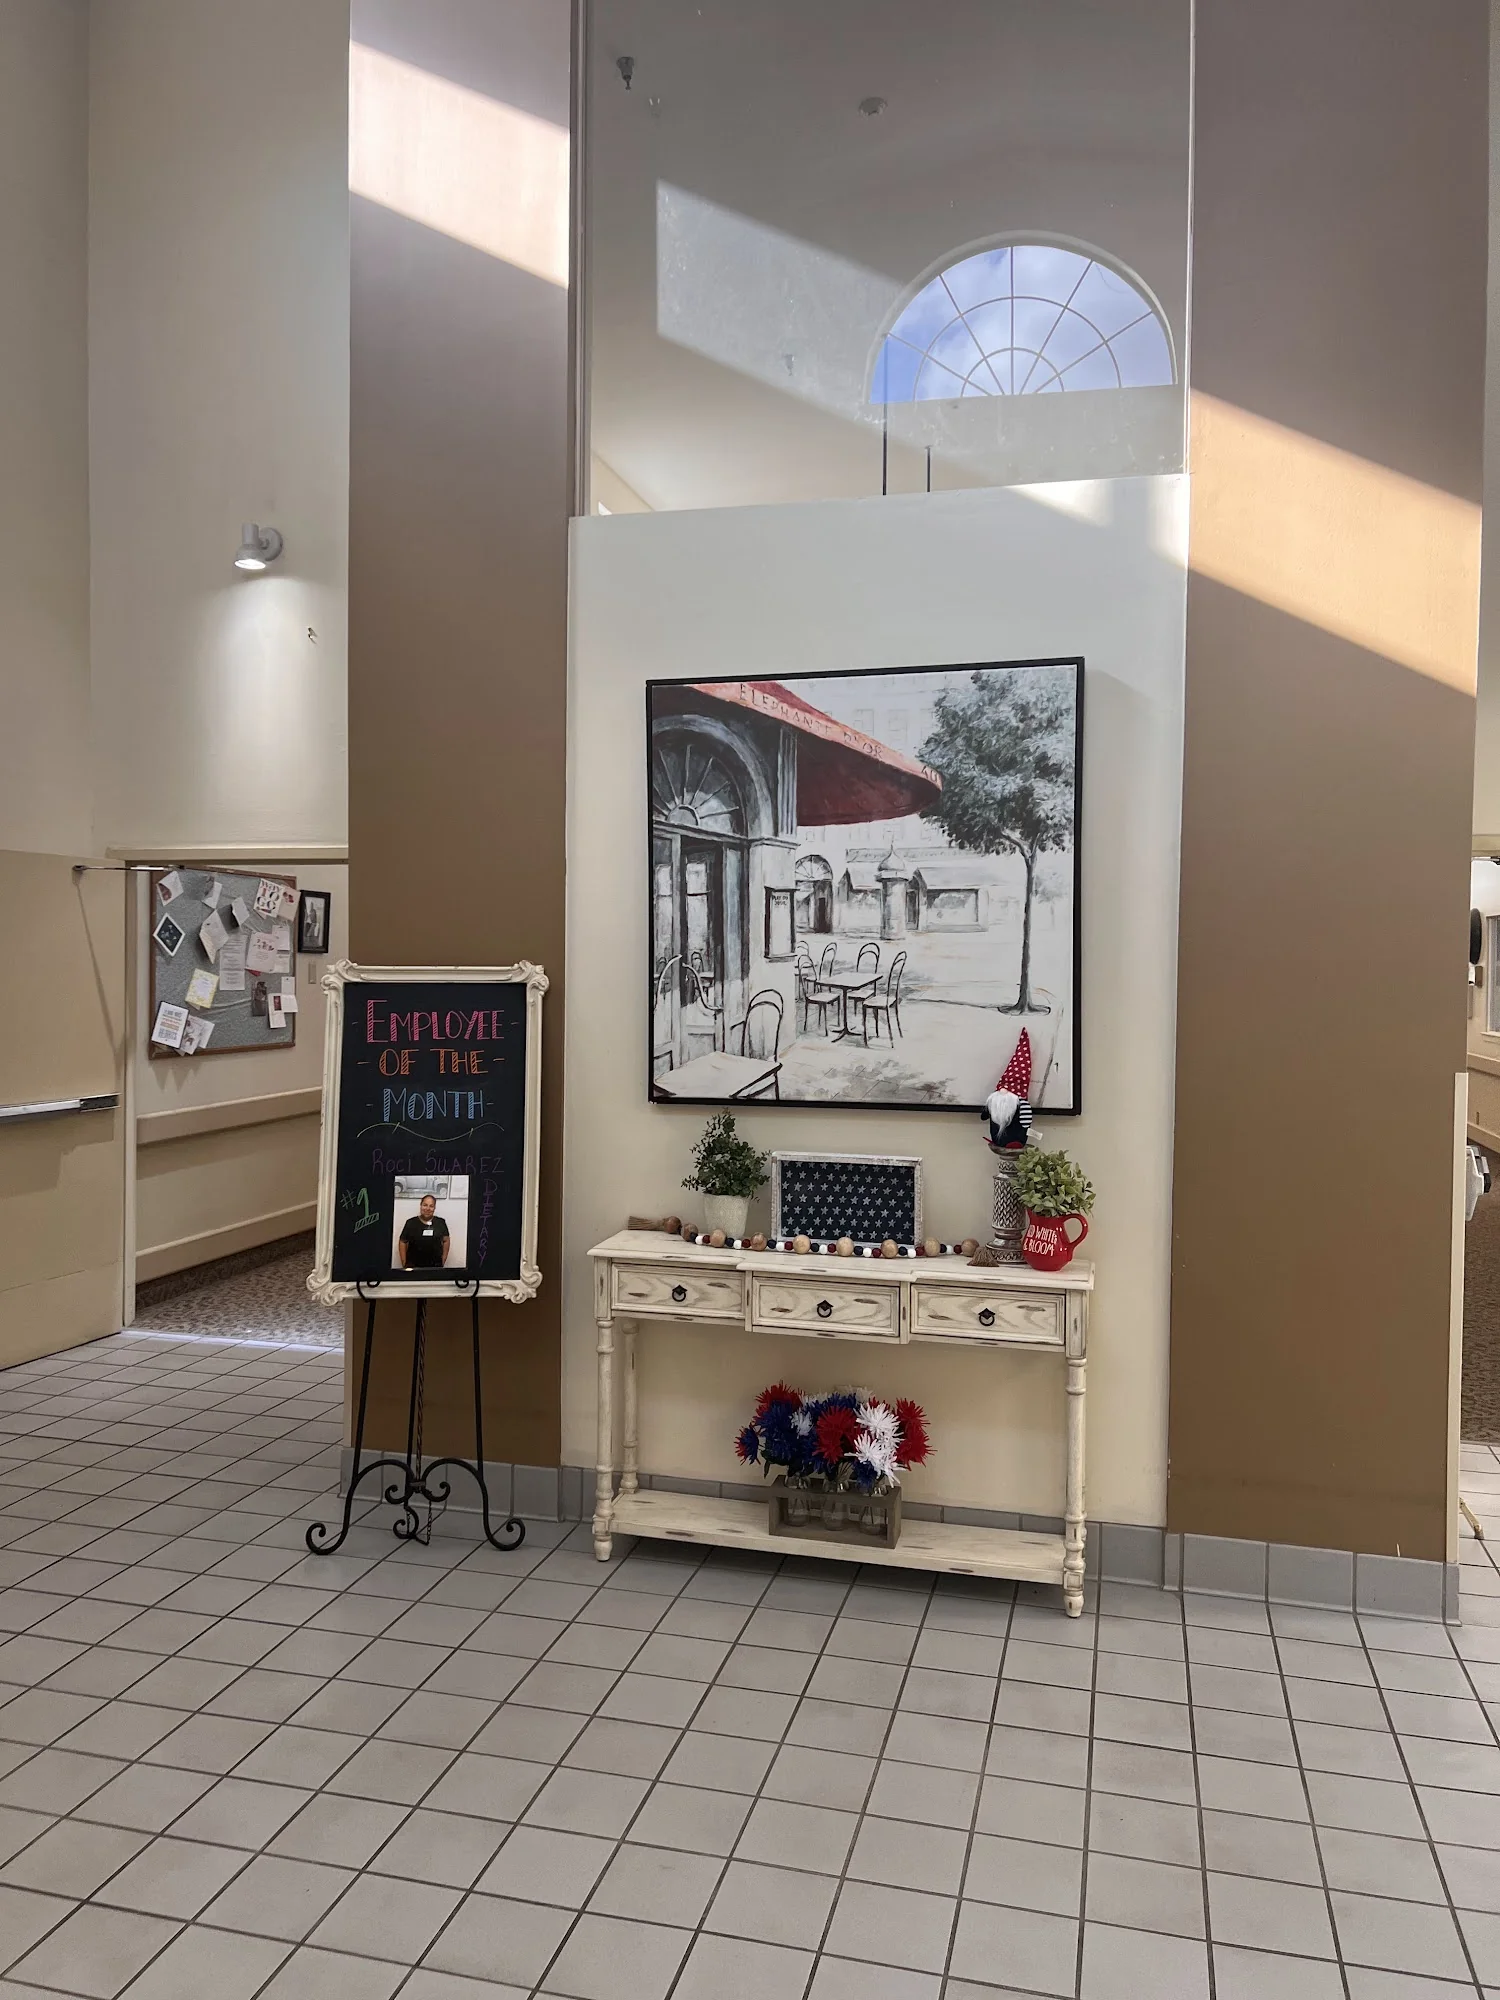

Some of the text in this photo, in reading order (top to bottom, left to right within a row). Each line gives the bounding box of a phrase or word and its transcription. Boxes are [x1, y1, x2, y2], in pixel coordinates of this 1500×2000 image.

[367, 1000, 504, 1043] EMPLOYEE
[379, 1048, 489, 1076] OF THE
[383, 1087, 485, 1122] MONTH
[340, 1187, 380, 1233] #1
[477, 1178, 498, 1268] DIETARY
[1029, 1239, 1054, 1256] BLOOM
